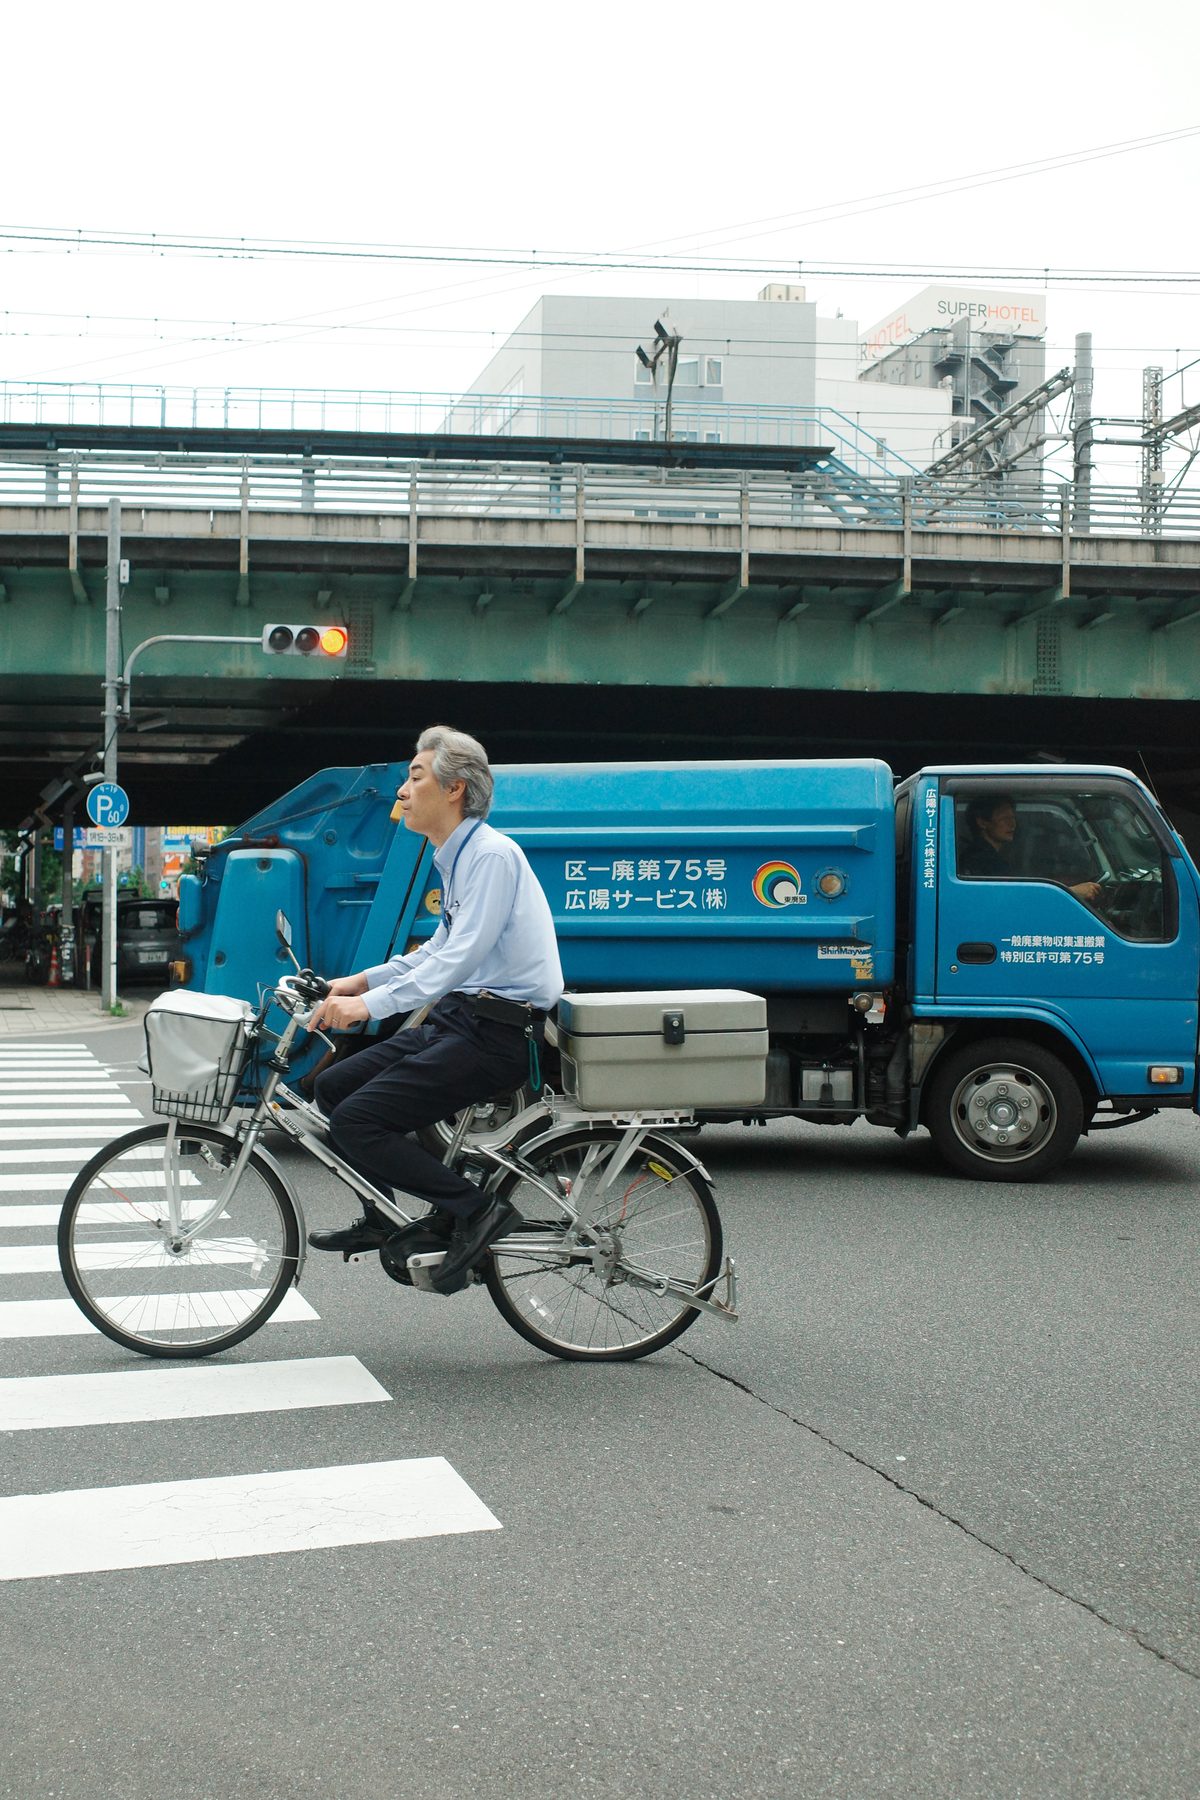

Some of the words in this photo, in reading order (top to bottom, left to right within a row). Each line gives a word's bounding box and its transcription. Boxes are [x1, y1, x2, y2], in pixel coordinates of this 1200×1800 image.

[97, 795, 113, 823] P
[923, 788, 937, 889] 広陽サービス株式会社
[564, 859, 728, 882] 区一廃第75号
[820, 947, 868, 956] ShinMayw
[1001, 935, 1105, 948] 一般廃棄物収集運搬業
